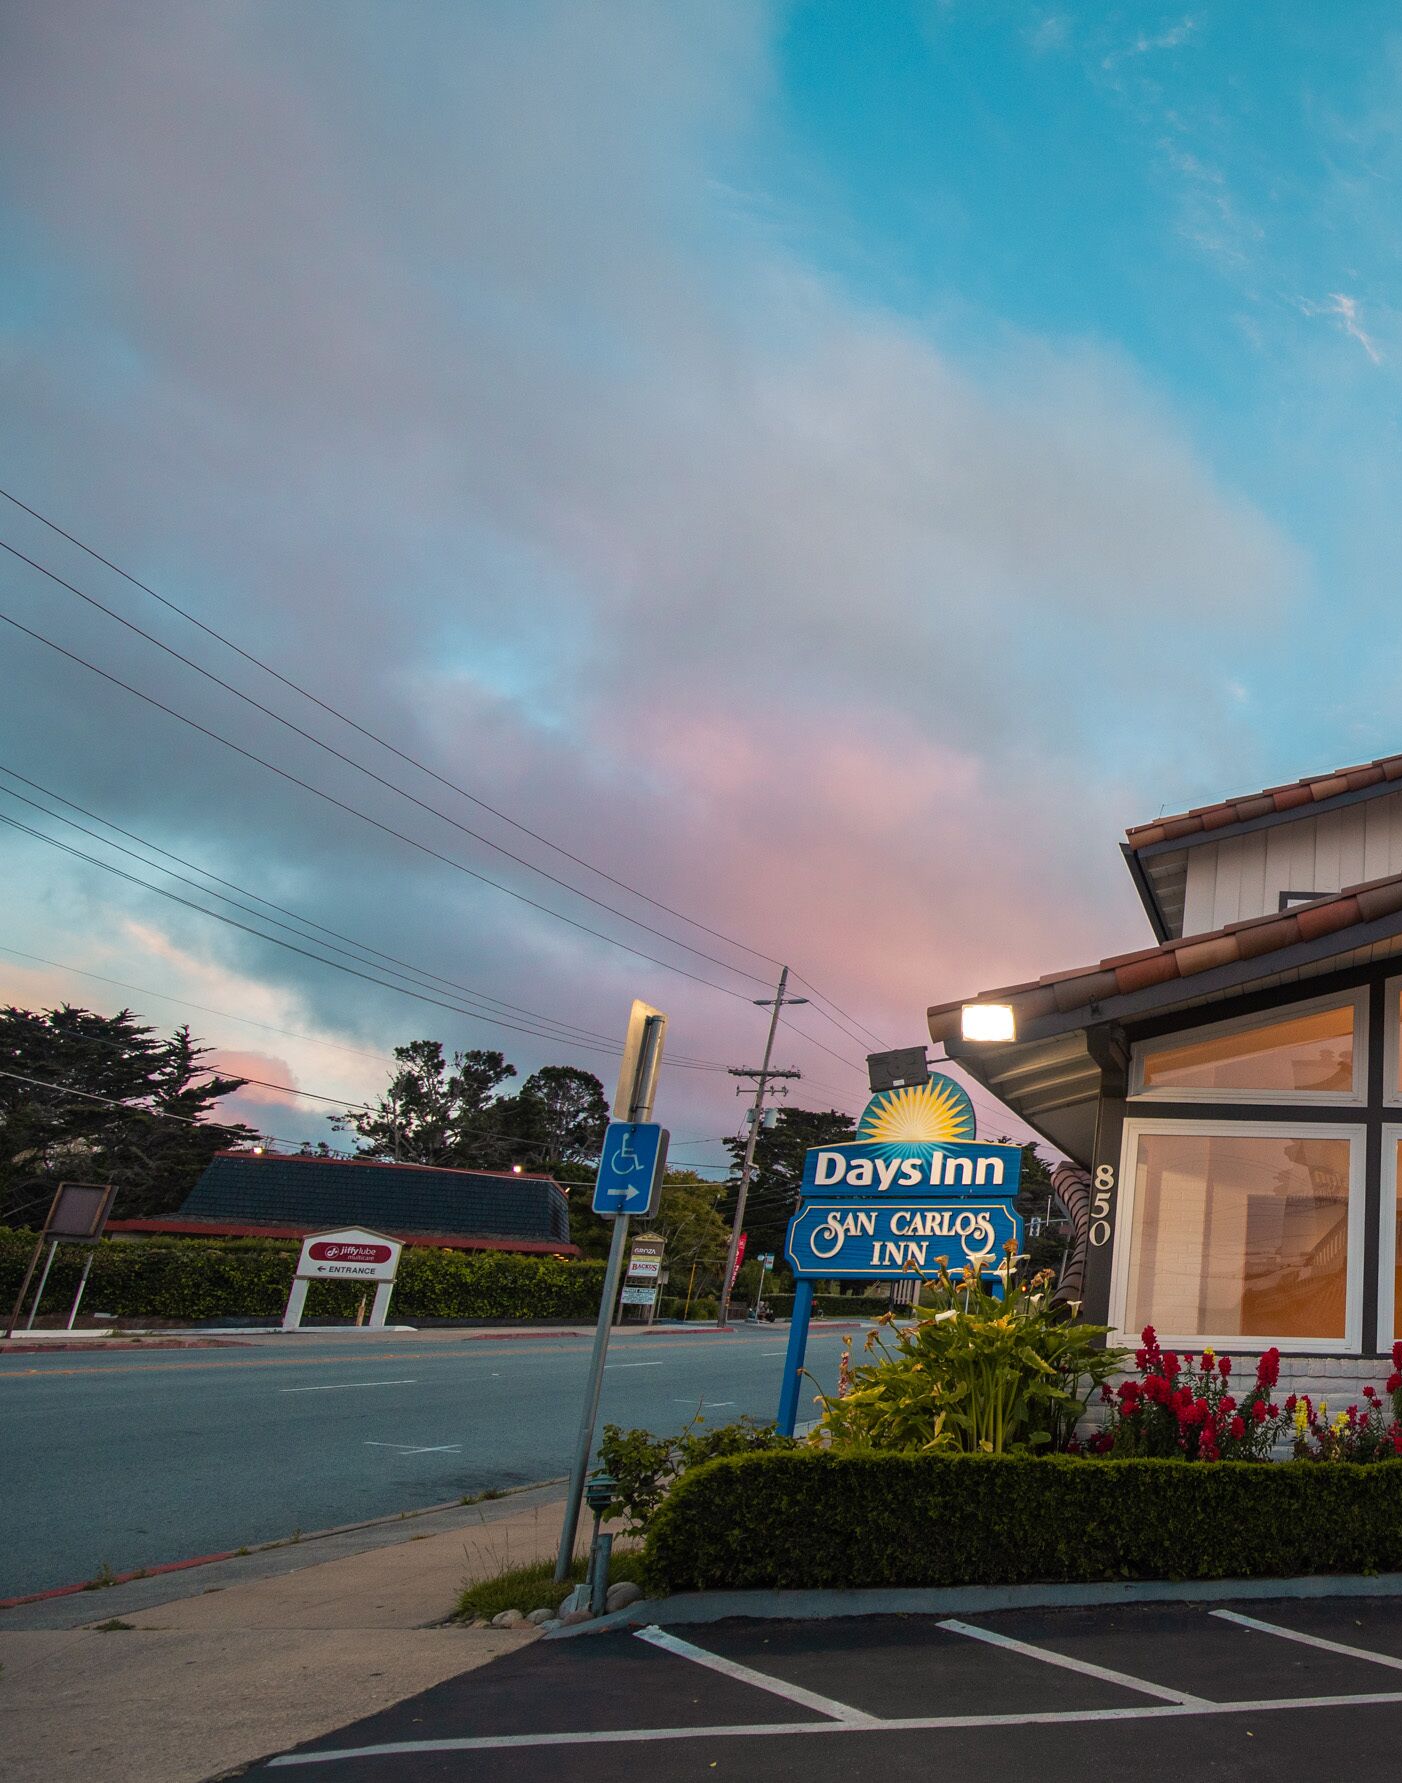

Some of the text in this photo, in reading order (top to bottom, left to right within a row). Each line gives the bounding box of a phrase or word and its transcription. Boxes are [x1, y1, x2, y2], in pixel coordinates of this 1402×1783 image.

[814, 1151, 1004, 1191] Days Inn
[1089, 1164, 1115, 1247] 850
[810, 1211, 996, 1259] SAN CARLOS
[869, 1241, 929, 1266] INN
[328, 1266, 376, 1275] ENTRANCE
